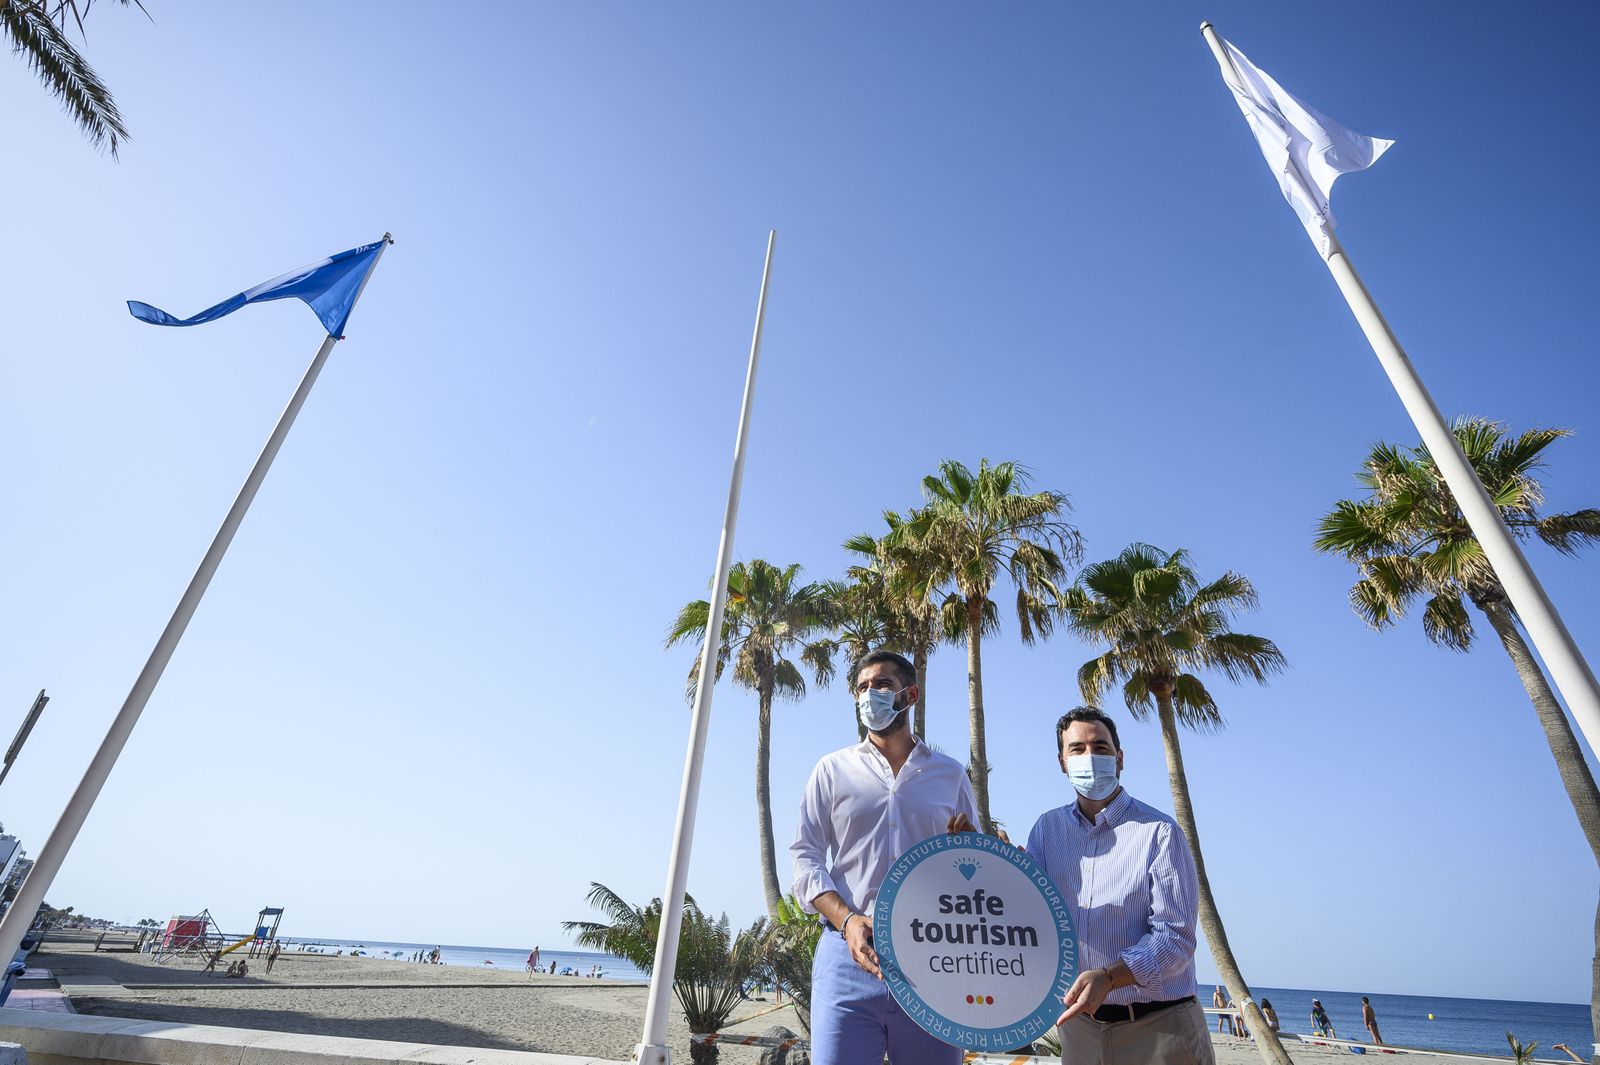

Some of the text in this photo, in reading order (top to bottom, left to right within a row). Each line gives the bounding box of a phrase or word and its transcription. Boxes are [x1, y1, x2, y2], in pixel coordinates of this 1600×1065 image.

[939, 889, 1004, 916] safe
[889, 835, 1074, 1005] INSTITUTE FOR SPANISH TOURISM QUALITY
[910, 918, 1039, 947] tourism
[877, 900, 1047, 1047] HEALTH RISK PREVENTION SYSTEM
[929, 952, 1025, 976] certified
